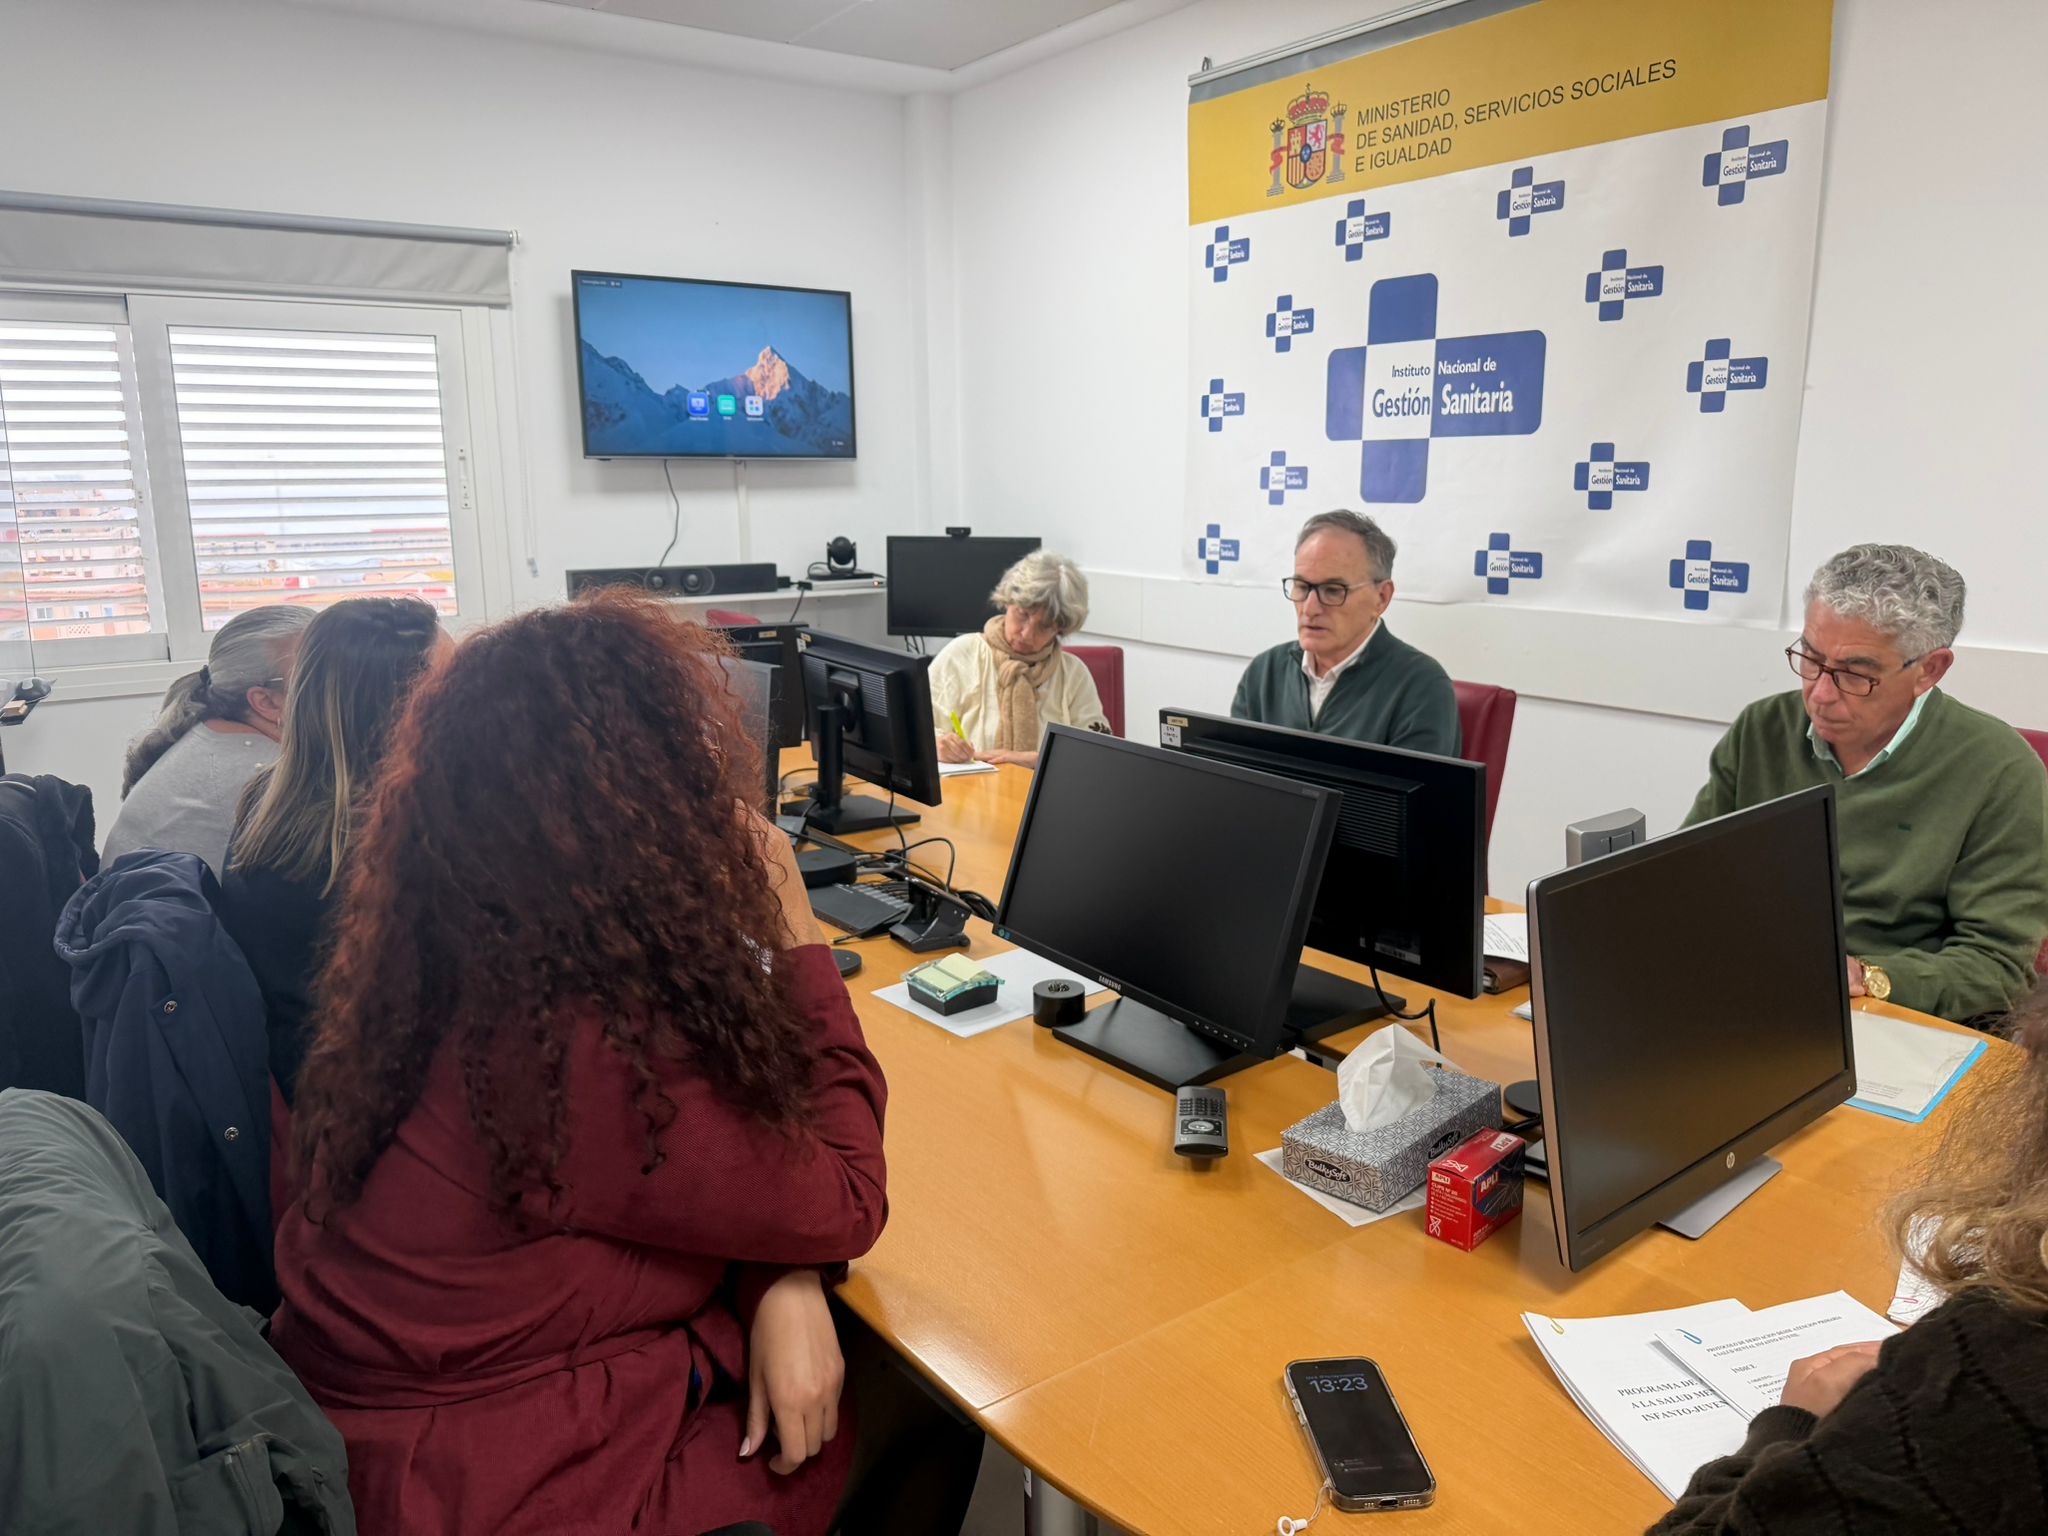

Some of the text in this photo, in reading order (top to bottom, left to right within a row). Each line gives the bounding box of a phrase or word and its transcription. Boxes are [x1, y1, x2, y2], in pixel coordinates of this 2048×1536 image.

[1355, 58, 1677, 150] DE SANIDAD, SERVICIOS SOCIALES
[1356, 88, 1450, 127] MINISTERIO
[1354, 137, 1453, 173] E IGUALDAD
[1750, 157, 1777, 172] Sanitaria
[1603, 281, 1654, 295] Gestión Sanitaria
[1391, 357, 1497, 378] Instituto Nacional de
[1730, 372, 1757, 384] Sanitaria
[1372, 380, 1514, 418] Gestión Sanitaria
[1591, 474, 1641, 485] Gestión Sanitaria
[1712, 574, 1739, 587] Sanitaria
[1098, 975, 1122, 991] SAMSUNG
[1307, 1160, 1347, 1180] BulkySoft
[1480, 1171, 1498, 1192] APLI
[1309, 1377, 1369, 1393] 13:23
[1617, 1383, 1681, 1397] PROGRAMA
[1640, 1399, 1657, 1408] LA
[1656, 1393, 1693, 1405] SALUD
